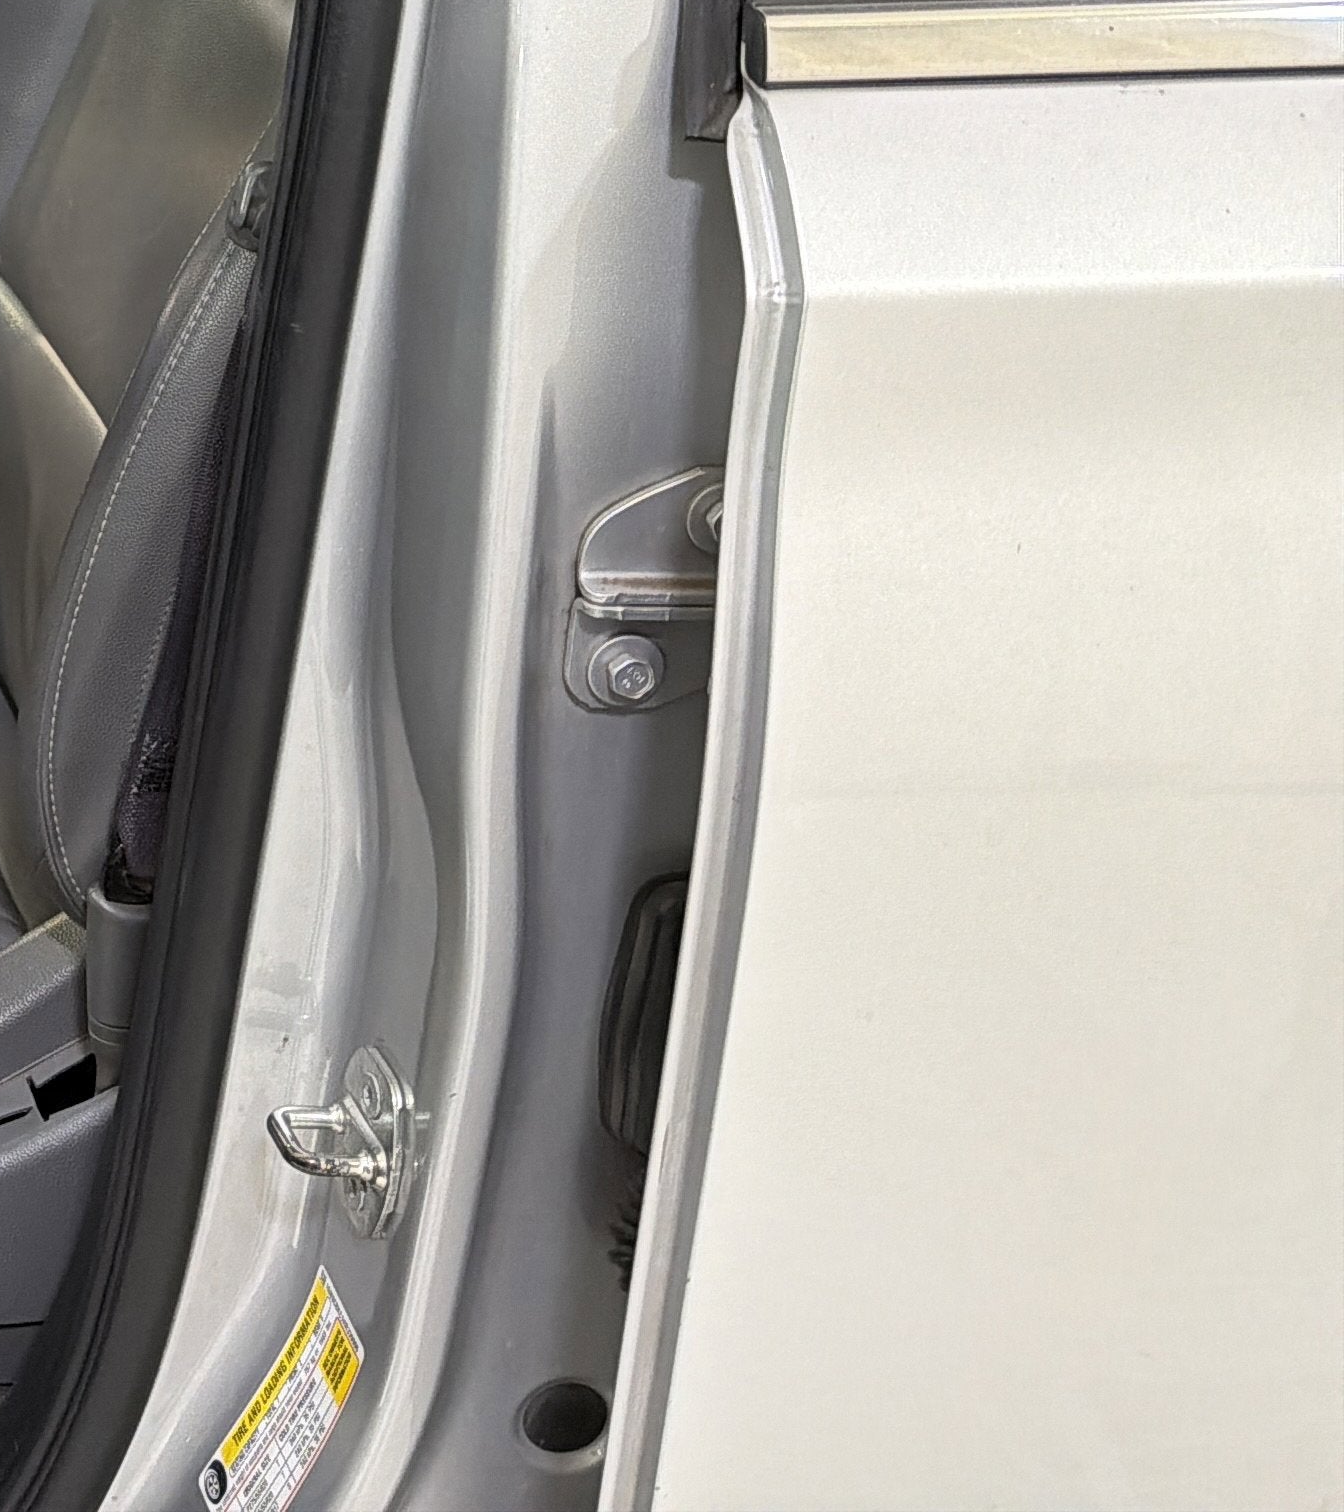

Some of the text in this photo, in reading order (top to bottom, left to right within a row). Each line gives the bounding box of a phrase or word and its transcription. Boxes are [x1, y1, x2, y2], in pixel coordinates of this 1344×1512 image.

[231, 1419, 248, 1448] TIRE
[245, 1397, 262, 1426] AND
[259, 1357, 287, 1405] LOADING
[283, 1293, 319, 1364] INFORMATION
